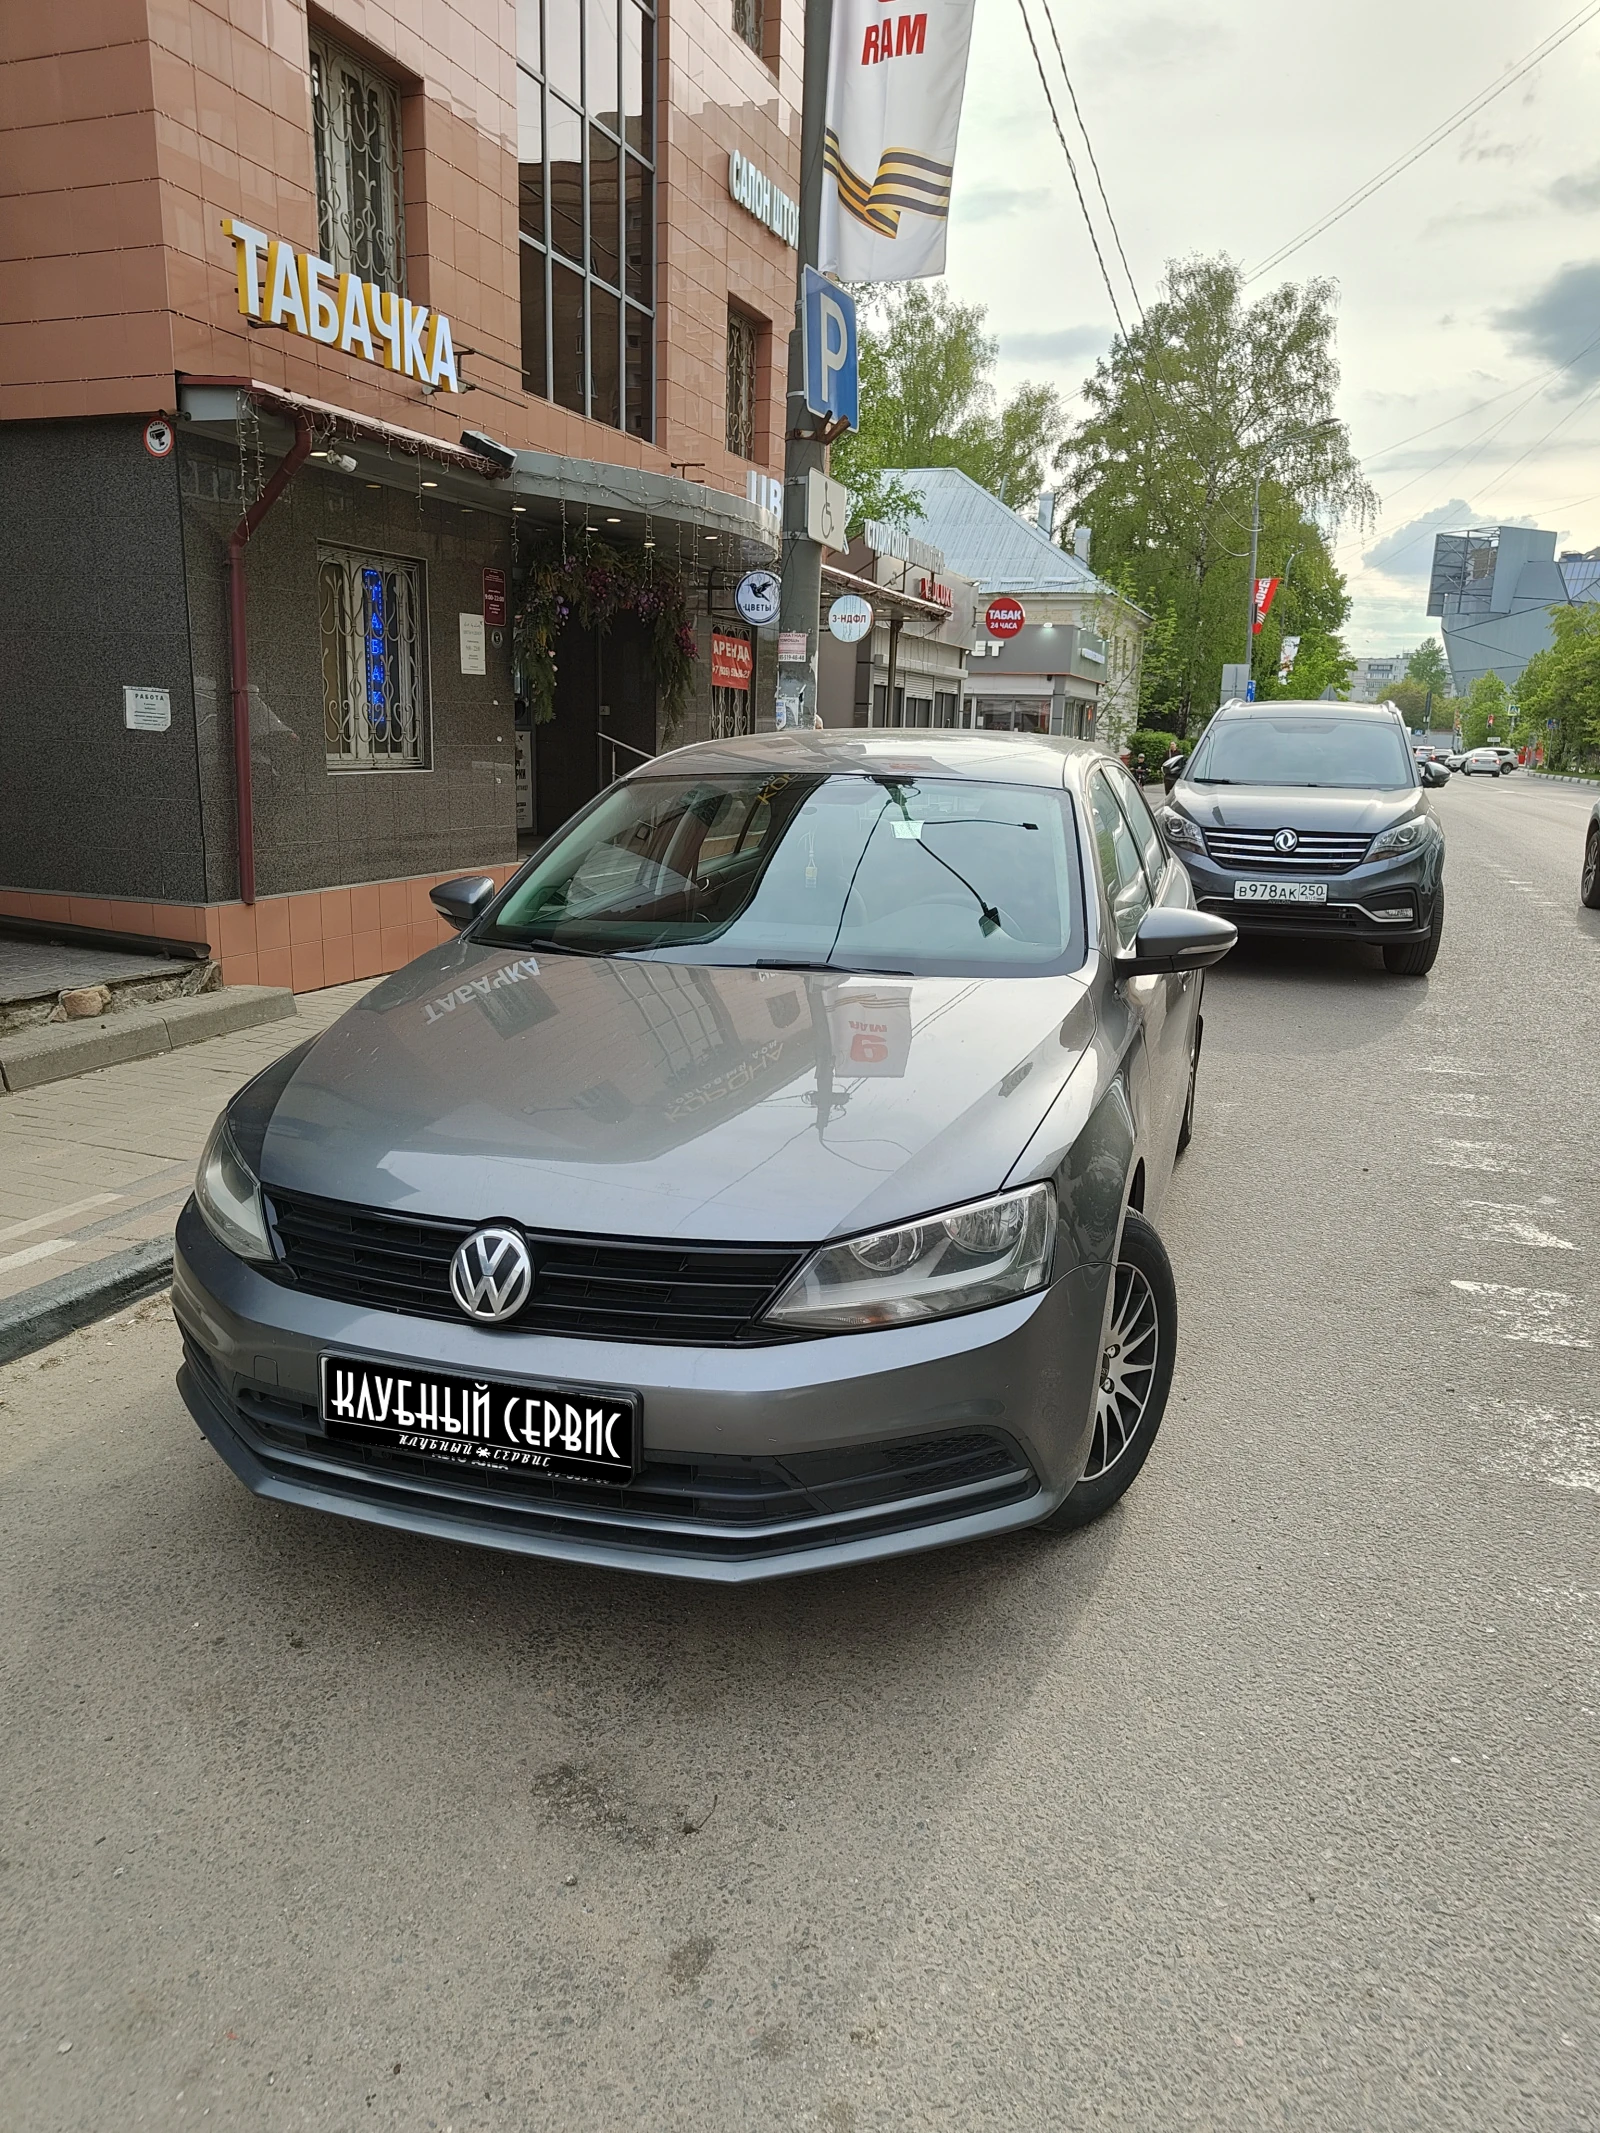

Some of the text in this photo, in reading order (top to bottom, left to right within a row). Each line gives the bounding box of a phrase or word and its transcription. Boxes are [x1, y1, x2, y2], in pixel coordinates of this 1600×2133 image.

[729, 149, 771, 227] САЛОН
[222, 219, 459, 393] ТАБАЧКА
[744, 603, 772, 612] ЦВЕТЫ
[832, 614, 867, 623] 3-НДФЛ
[988, 610, 1022, 620] ТАБАК
[1000, 622, 1018, 630] ЧАСА
[713, 640, 751, 663] АРЕНДА
[1239, 883, 1324, 899] В978АК 250
